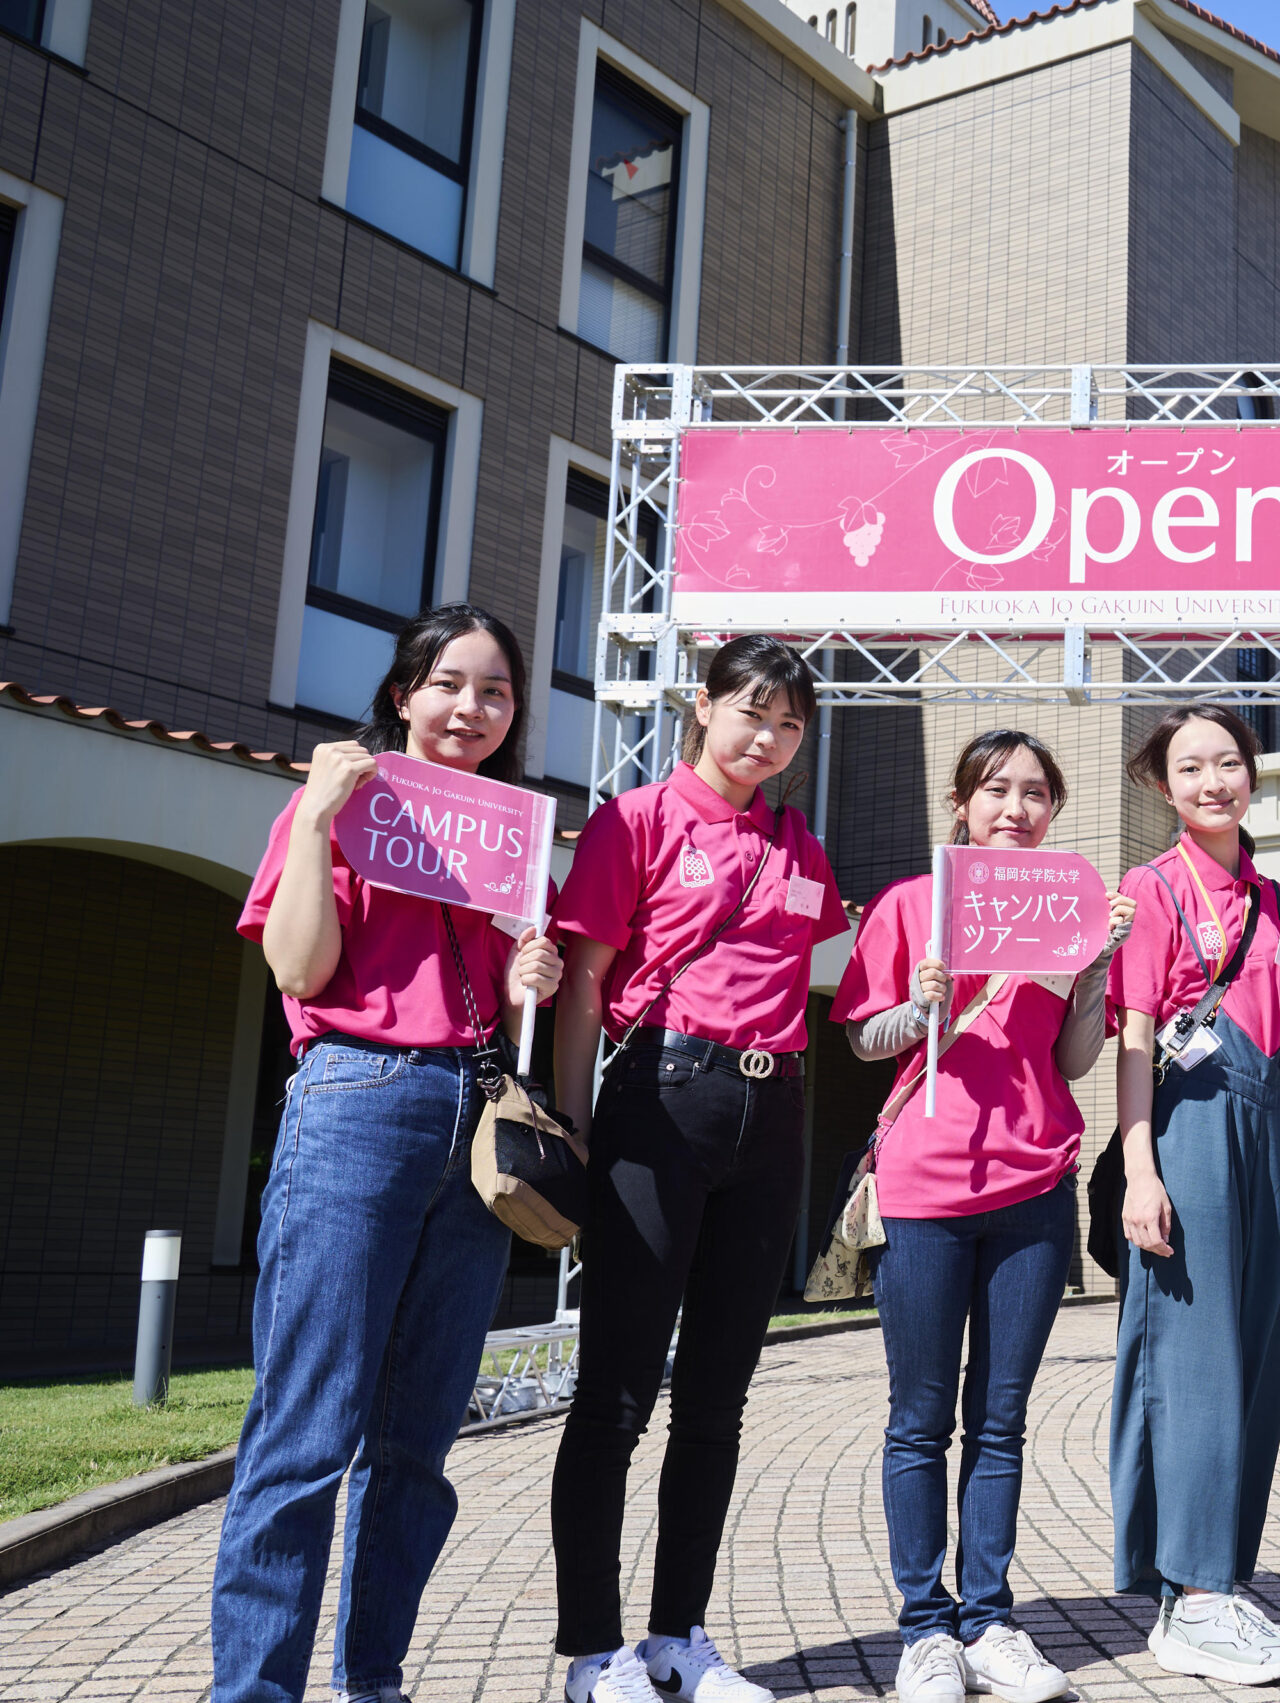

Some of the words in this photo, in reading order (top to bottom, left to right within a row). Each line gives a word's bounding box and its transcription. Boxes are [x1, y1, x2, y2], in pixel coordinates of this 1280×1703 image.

[1107, 447, 1237, 476] オープン
[940, 597, 1040, 614] FUKUOKA
[1081, 596, 1164, 614] GAKUIN
[369, 792, 524, 858] CAMPUS
[363, 827, 469, 884] TOUR
[994, 866, 1080, 884] 福岡女学院大学
[963, 890, 1081, 923] キャンパス
[963, 924, 1040, 954] ツアー
